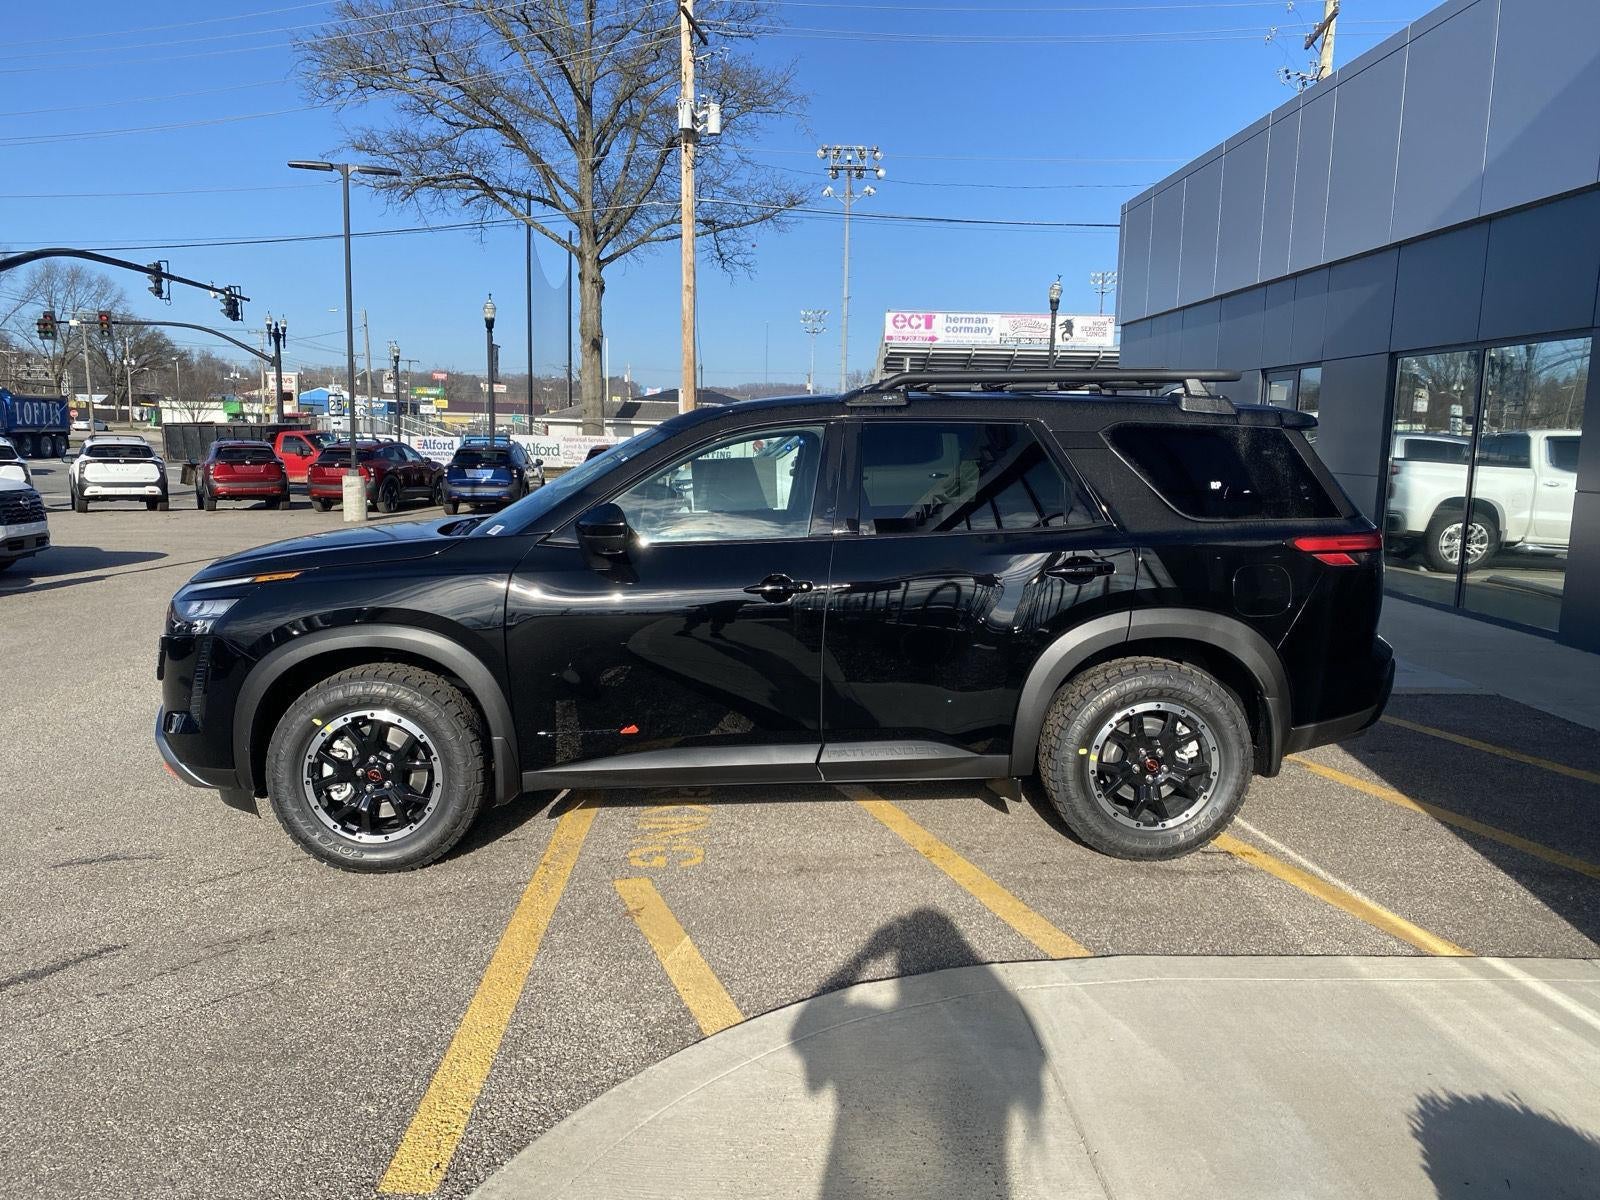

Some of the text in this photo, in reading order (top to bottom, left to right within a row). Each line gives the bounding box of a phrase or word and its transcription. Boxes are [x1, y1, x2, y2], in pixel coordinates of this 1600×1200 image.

[945, 314, 988, 325] herman
[945, 325, 993, 335] cormany
[330, 400, 342, 411] 25
[15, 401, 61, 425] LOFTIS
[422, 439, 454, 450] Alford
[526, 442, 560, 456] Alford
[317, 834, 365, 859] TOYO
